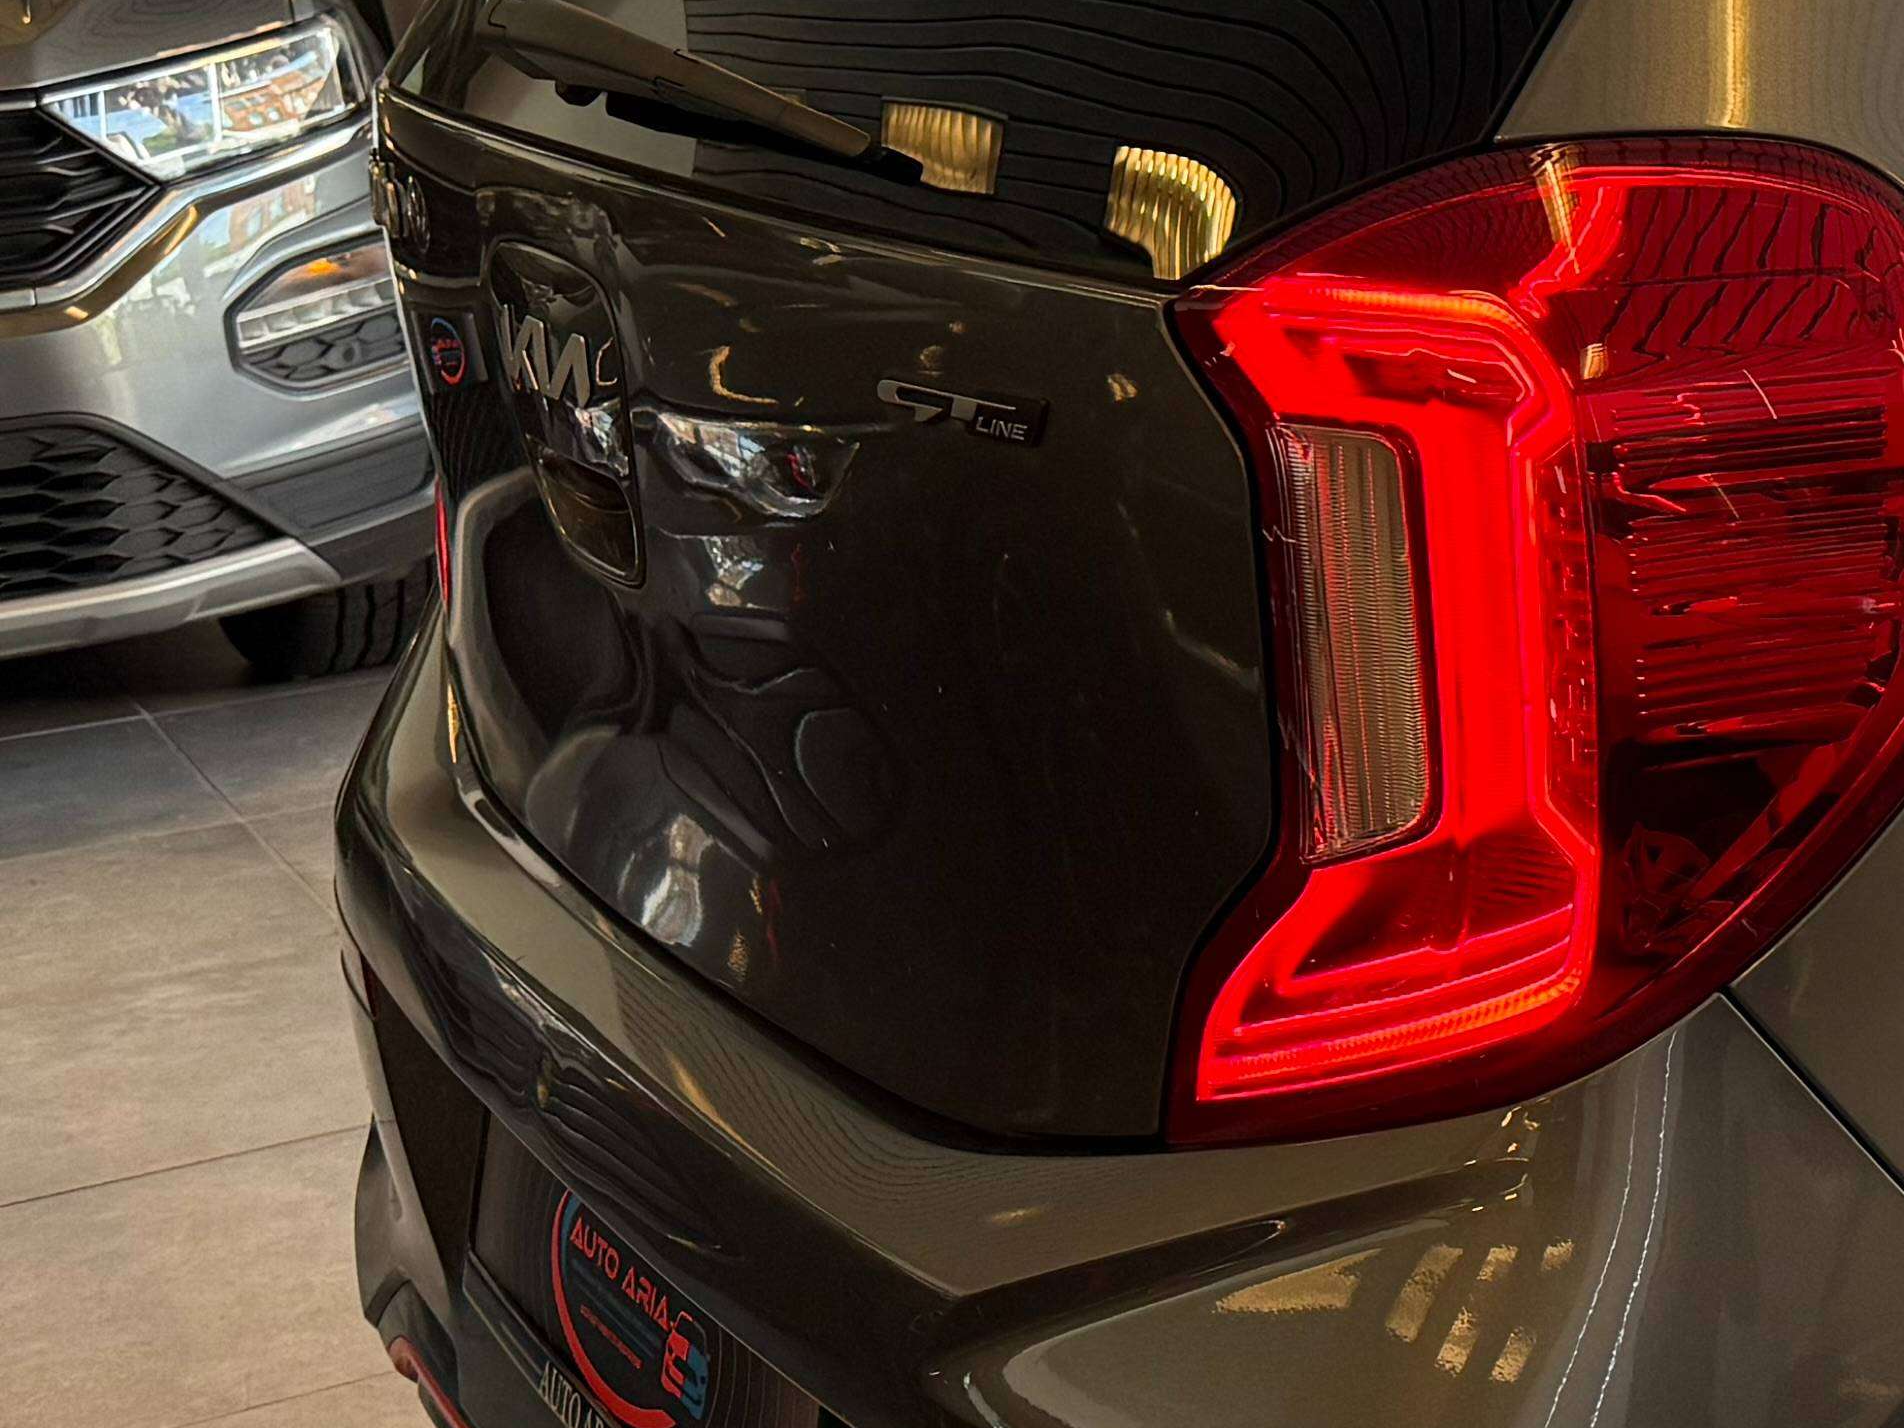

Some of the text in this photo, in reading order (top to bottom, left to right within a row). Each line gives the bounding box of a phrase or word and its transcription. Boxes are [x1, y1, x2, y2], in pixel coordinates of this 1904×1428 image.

[500, 304, 591, 409] KIA
[975, 415, 1029, 442] LINE
[570, 1216, 622, 1281] AUTO
[621, 1266, 673, 1334] ARIA
